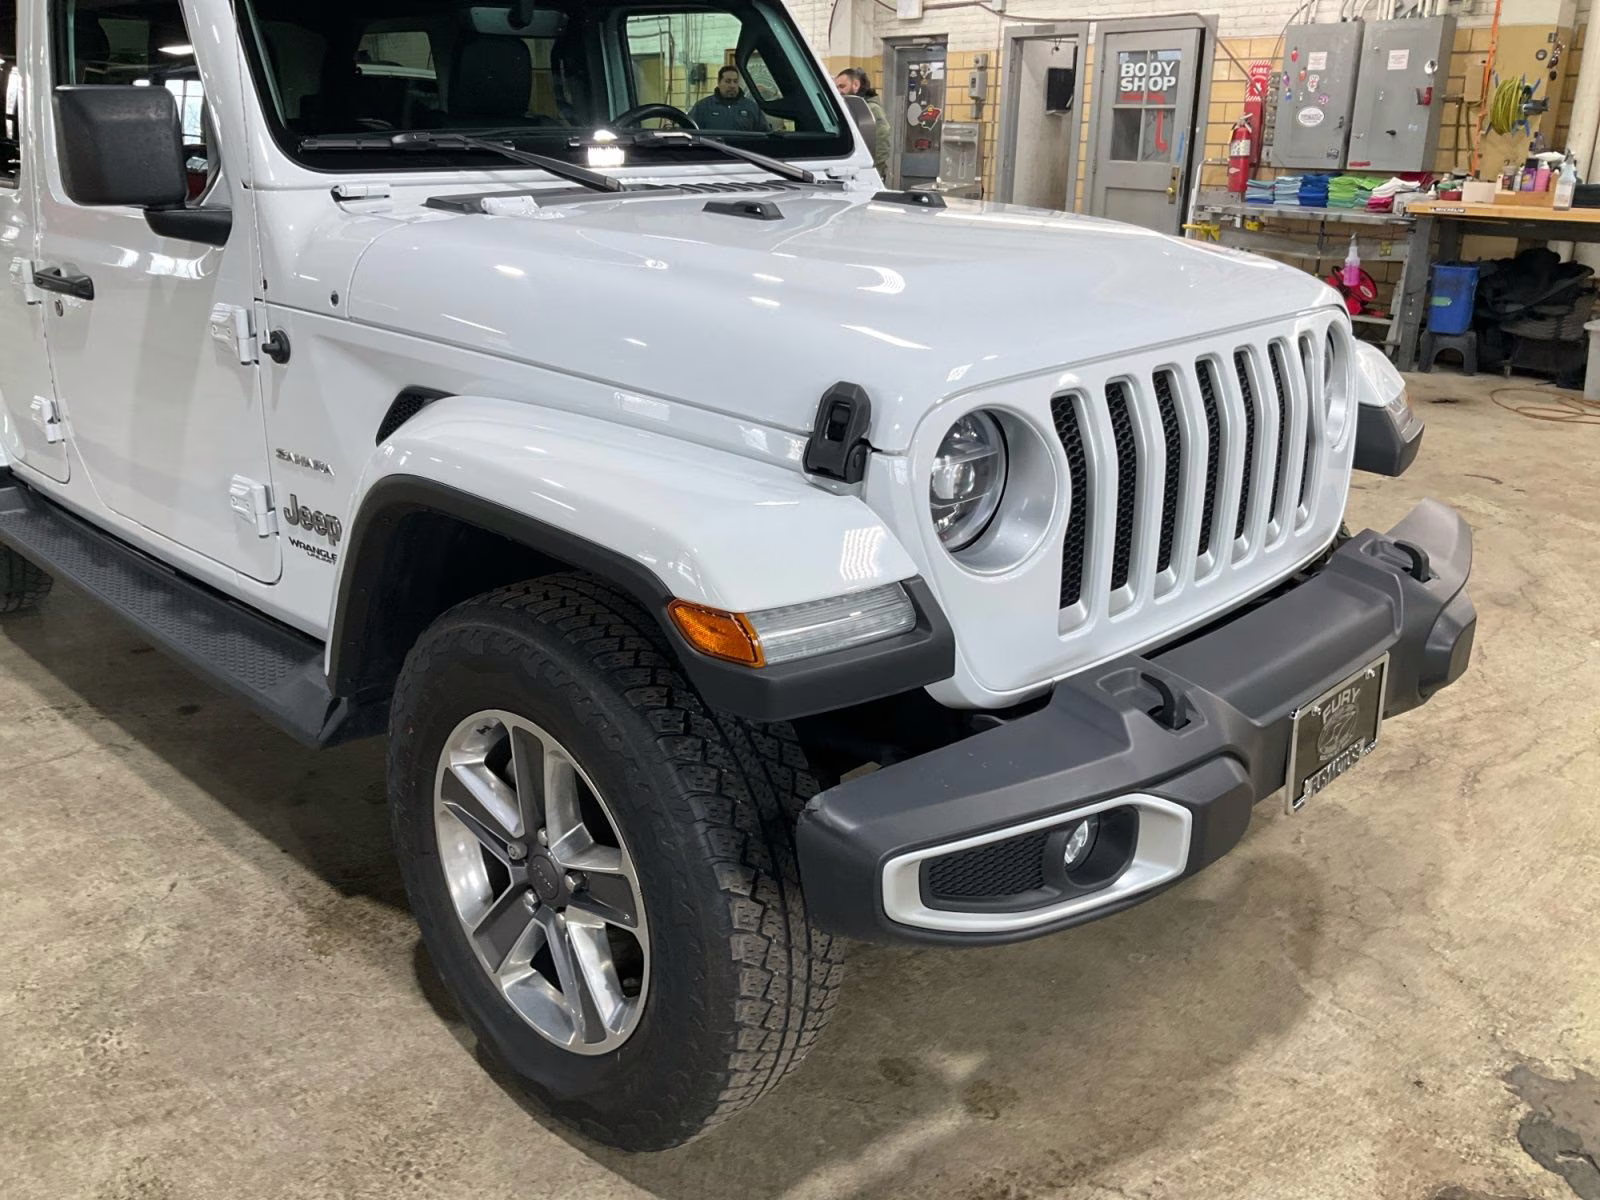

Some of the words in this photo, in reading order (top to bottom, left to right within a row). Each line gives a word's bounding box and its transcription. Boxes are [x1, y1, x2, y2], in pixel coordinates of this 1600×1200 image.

[1120, 61, 1175, 77] BODY
[1252, 66, 1268, 74] FIRE
[1120, 76, 1176, 92] SHOP
[283, 493, 343, 547] Jeep
[288, 536, 338, 560] WRANGLE
[1322, 687, 1361, 725] FURY
